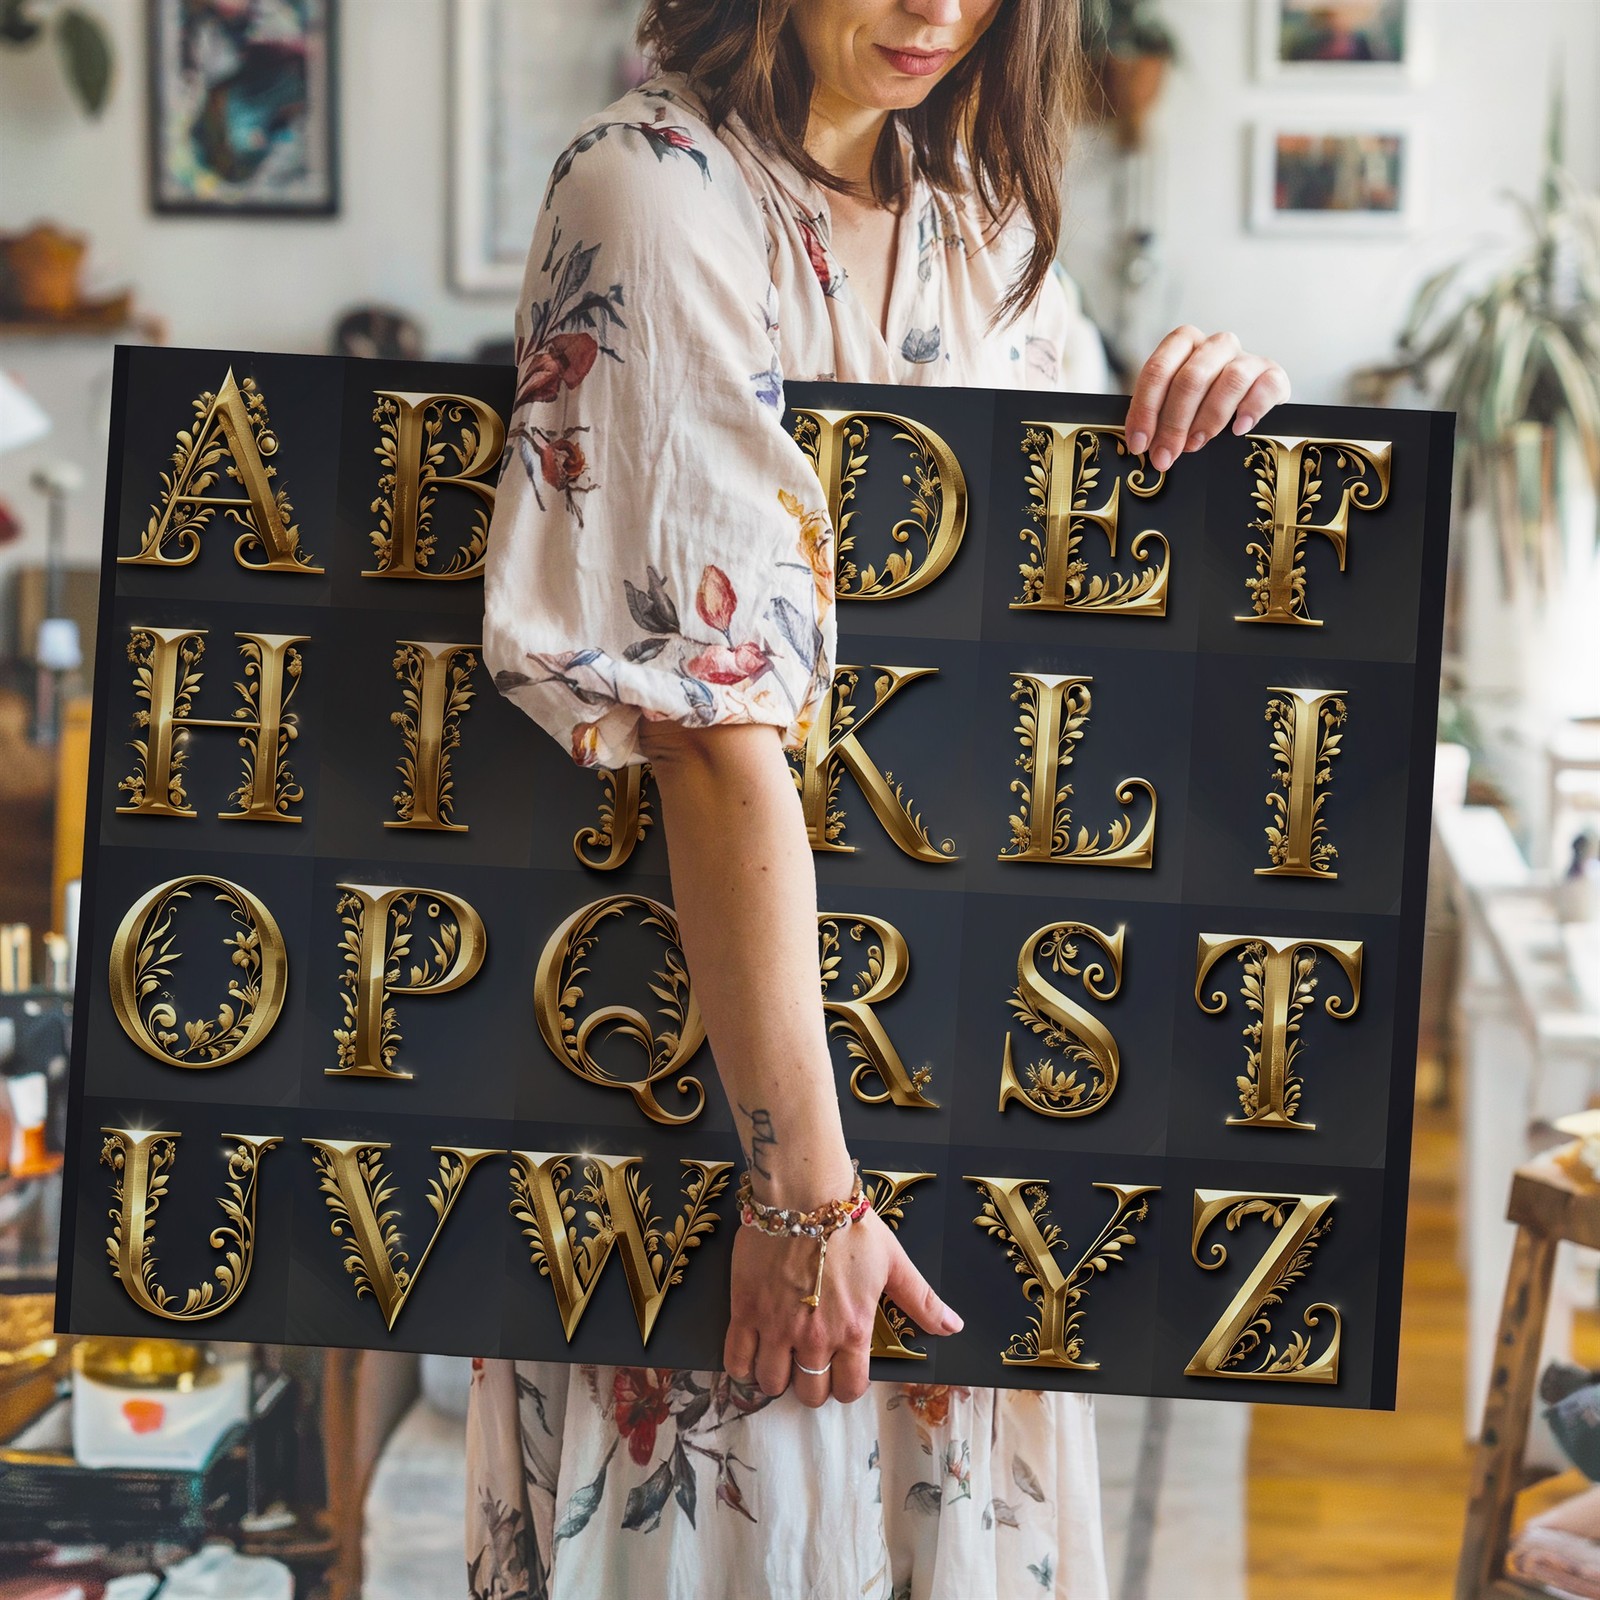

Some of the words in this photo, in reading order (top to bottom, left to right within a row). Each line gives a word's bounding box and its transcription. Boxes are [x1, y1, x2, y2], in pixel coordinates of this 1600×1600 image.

[117, 366, 324, 575] A
[361, 391, 506, 580] B
[791, 408, 968, 600] D
[1009, 420, 1170, 617] E
[1235, 434, 1393, 626] F
[116, 626, 312, 823] H
[384, 640, 484, 832] I
[789, 664, 960, 862] K
[998, 672, 1157, 869] L
[1254, 687, 1349, 879] I
[108, 874, 288, 1069] O
[324, 883, 487, 1079] P
[534, 894, 706, 1125] Q
[816, 911, 941, 1109] R
[999, 921, 1126, 1118] S
[1195, 932, 1364, 1130] T
[100, 1127, 284, 1321] U
[301, 1138, 508, 1332] V
[508, 1150, 735, 1348] W
[962, 1176, 1162, 1371] Y
[1184, 1189, 1341, 1385] Z
